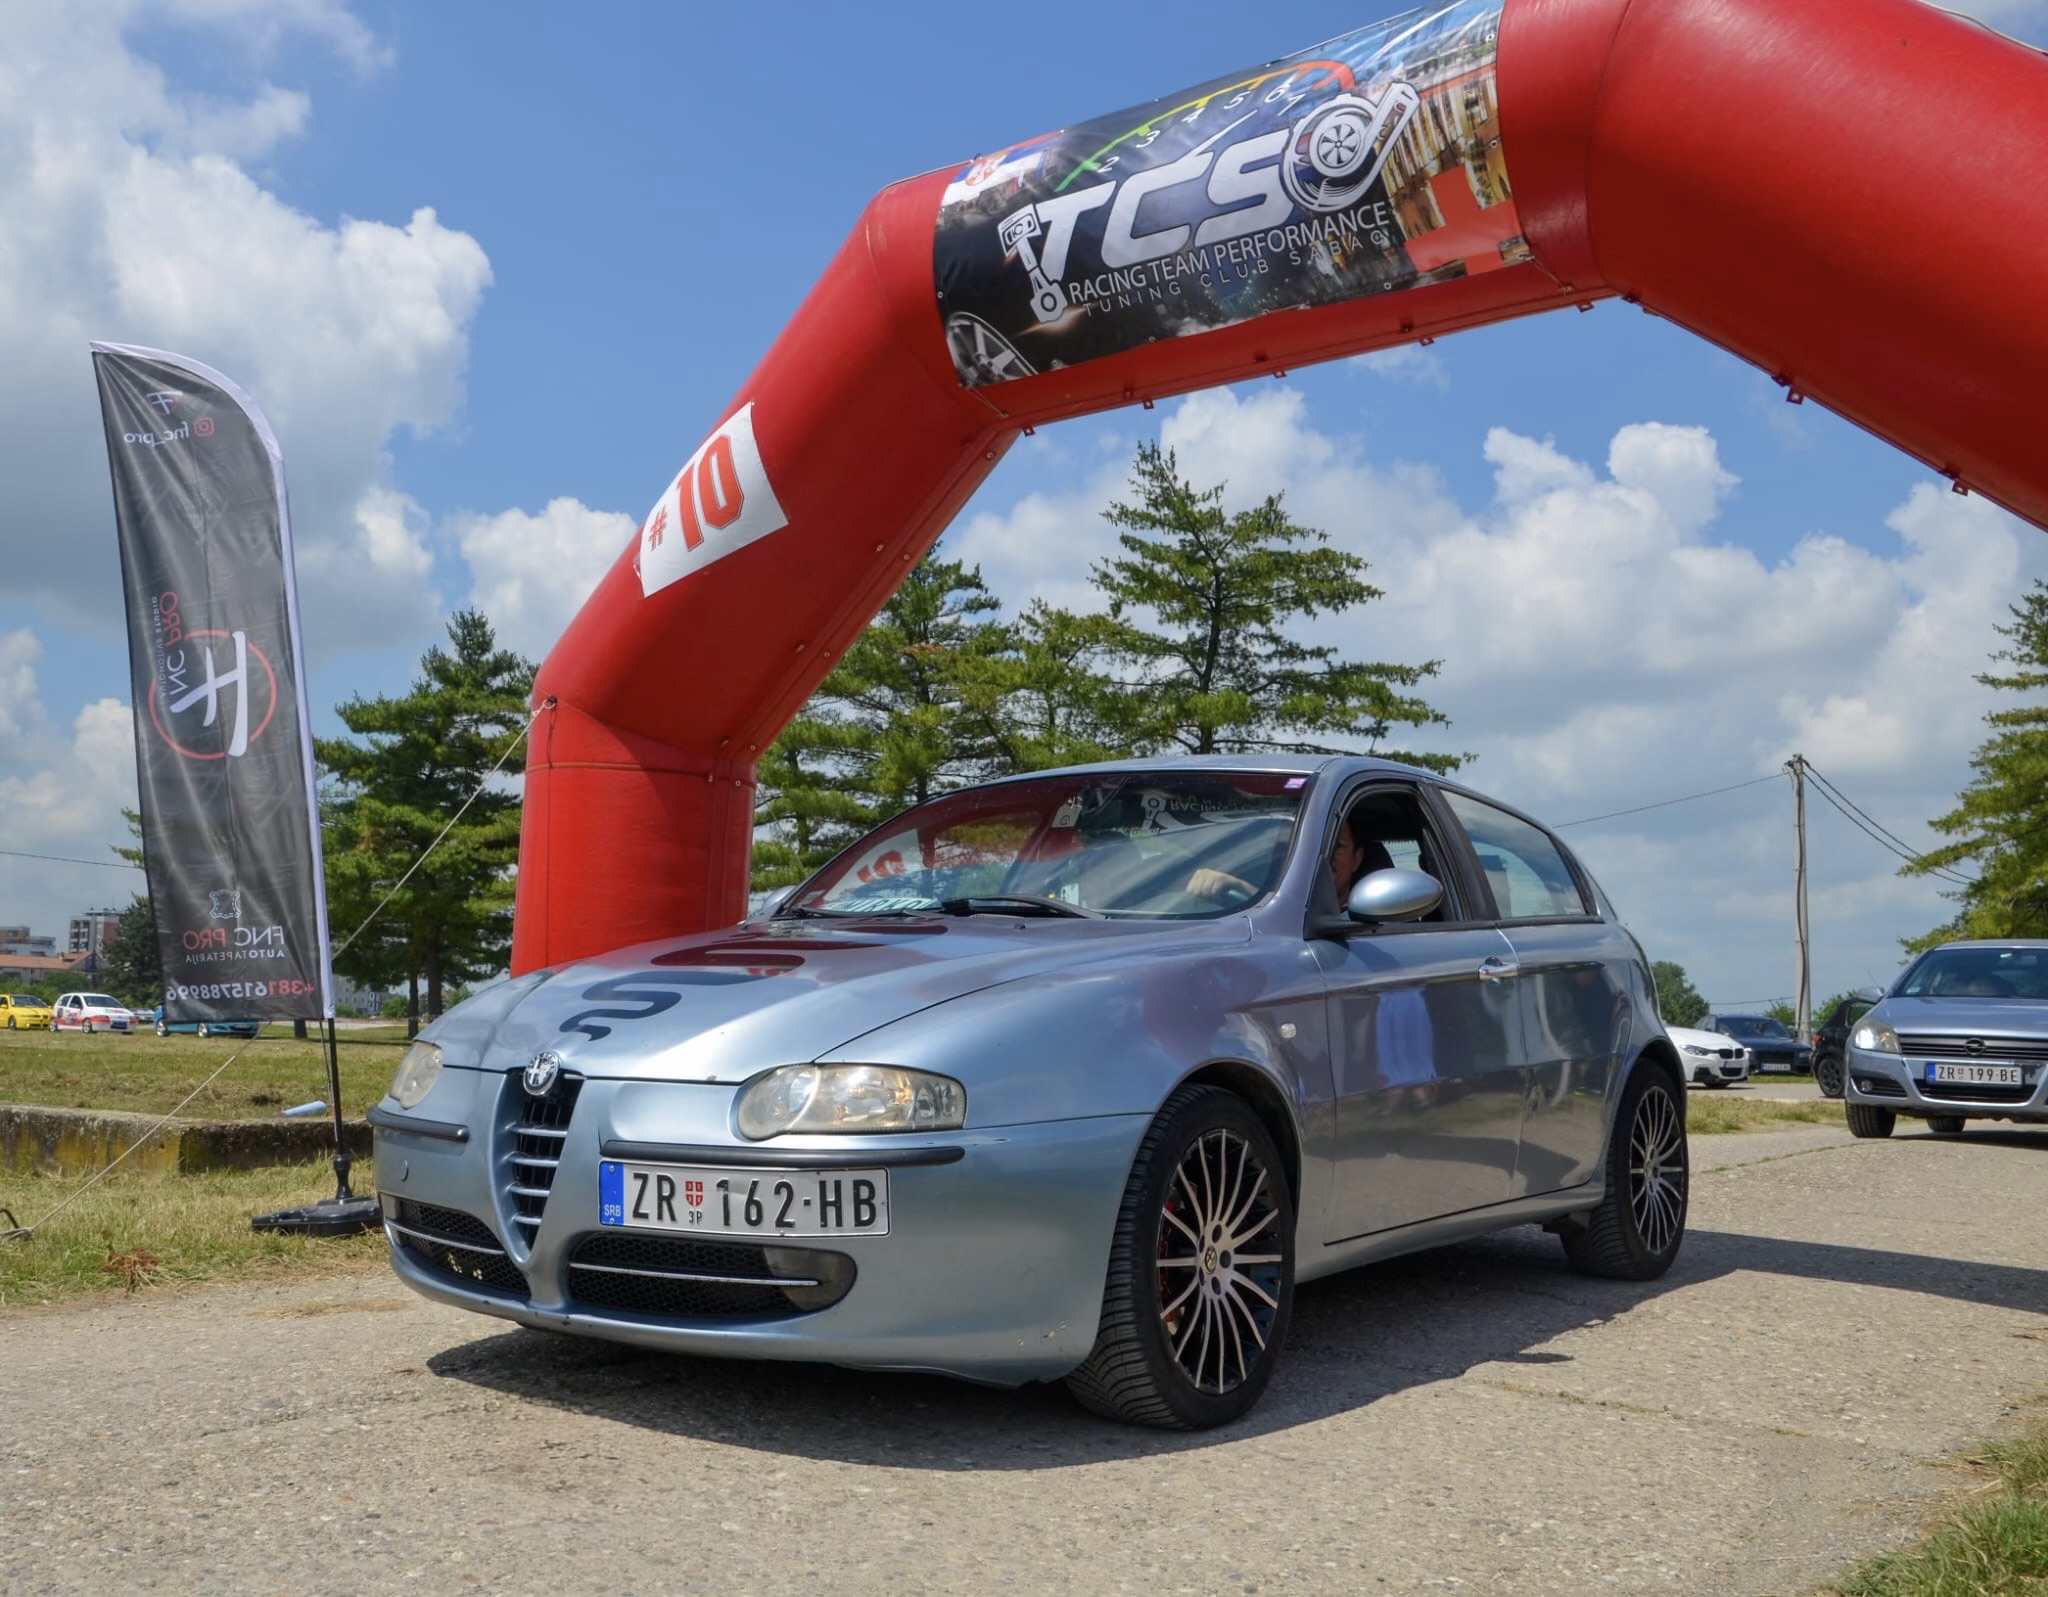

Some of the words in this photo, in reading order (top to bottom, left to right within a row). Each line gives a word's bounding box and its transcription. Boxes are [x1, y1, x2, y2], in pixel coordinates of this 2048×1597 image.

[1068, 265, 1147, 304] RACING
[1147, 249, 1210, 283] TEAM
[1213, 201, 1390, 267] PERFORMANCE
[1083, 281, 1181, 317] TUNING
[1200, 258, 1269, 288] CLUB
[1938, 1066, 1955, 1080] ZR
[604, 1203, 622, 1217] SRB
[632, 1171, 677, 1223] ZR
